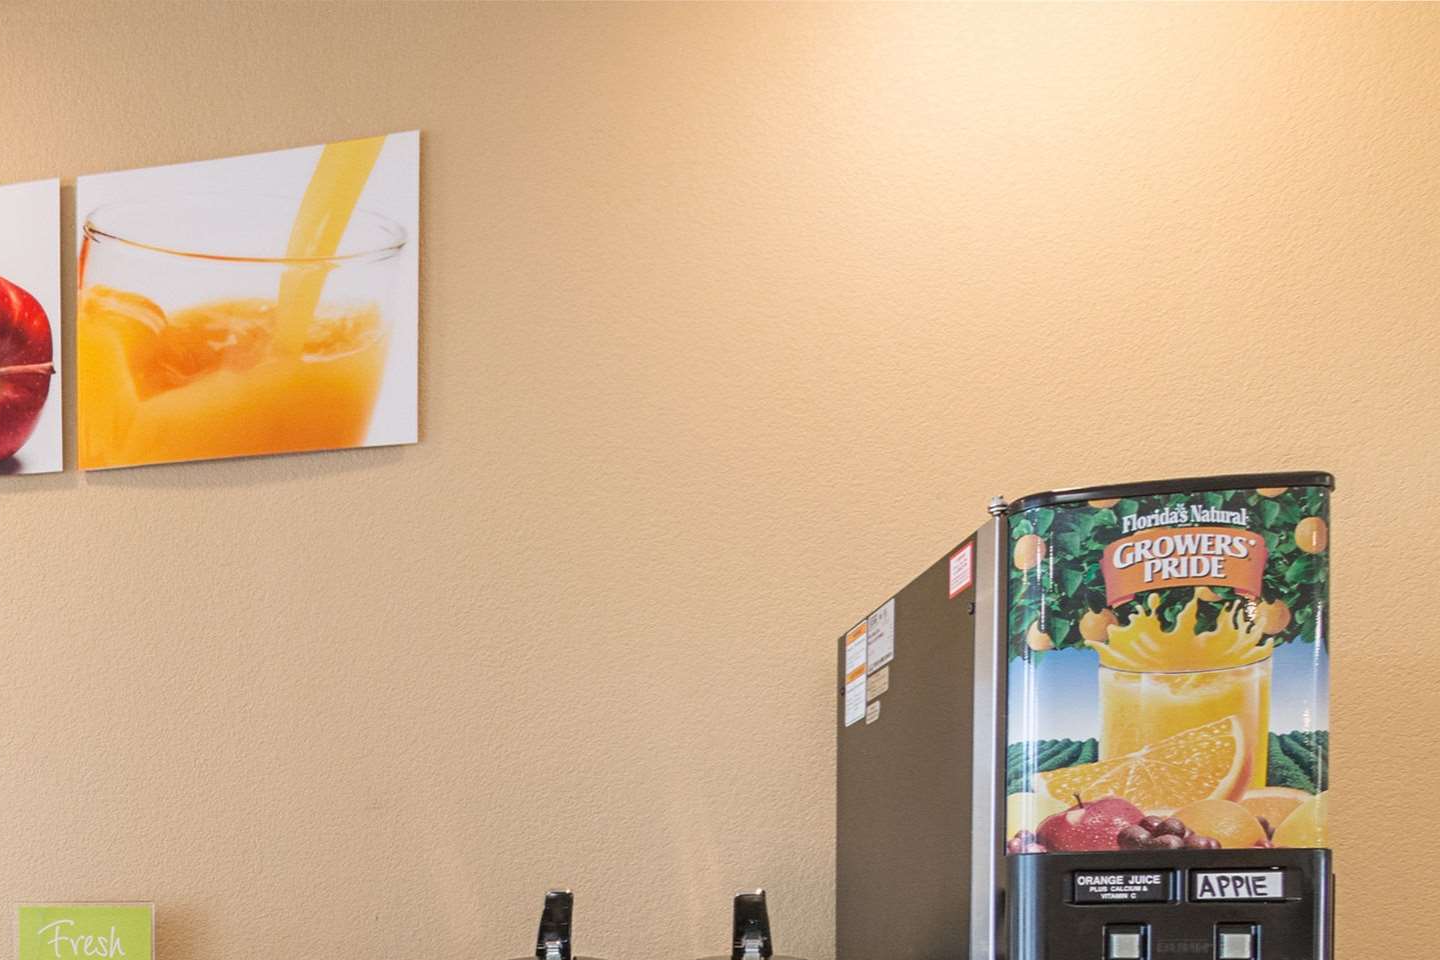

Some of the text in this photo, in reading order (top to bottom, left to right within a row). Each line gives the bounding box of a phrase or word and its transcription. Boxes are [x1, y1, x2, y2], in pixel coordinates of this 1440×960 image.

[1191, 504, 1247, 527] Natural
[1143, 555, 1227, 583] PRIDE
[1076, 874, 1162, 885] ORANGE JUICE
[37, 919, 126, 959] Fresh
